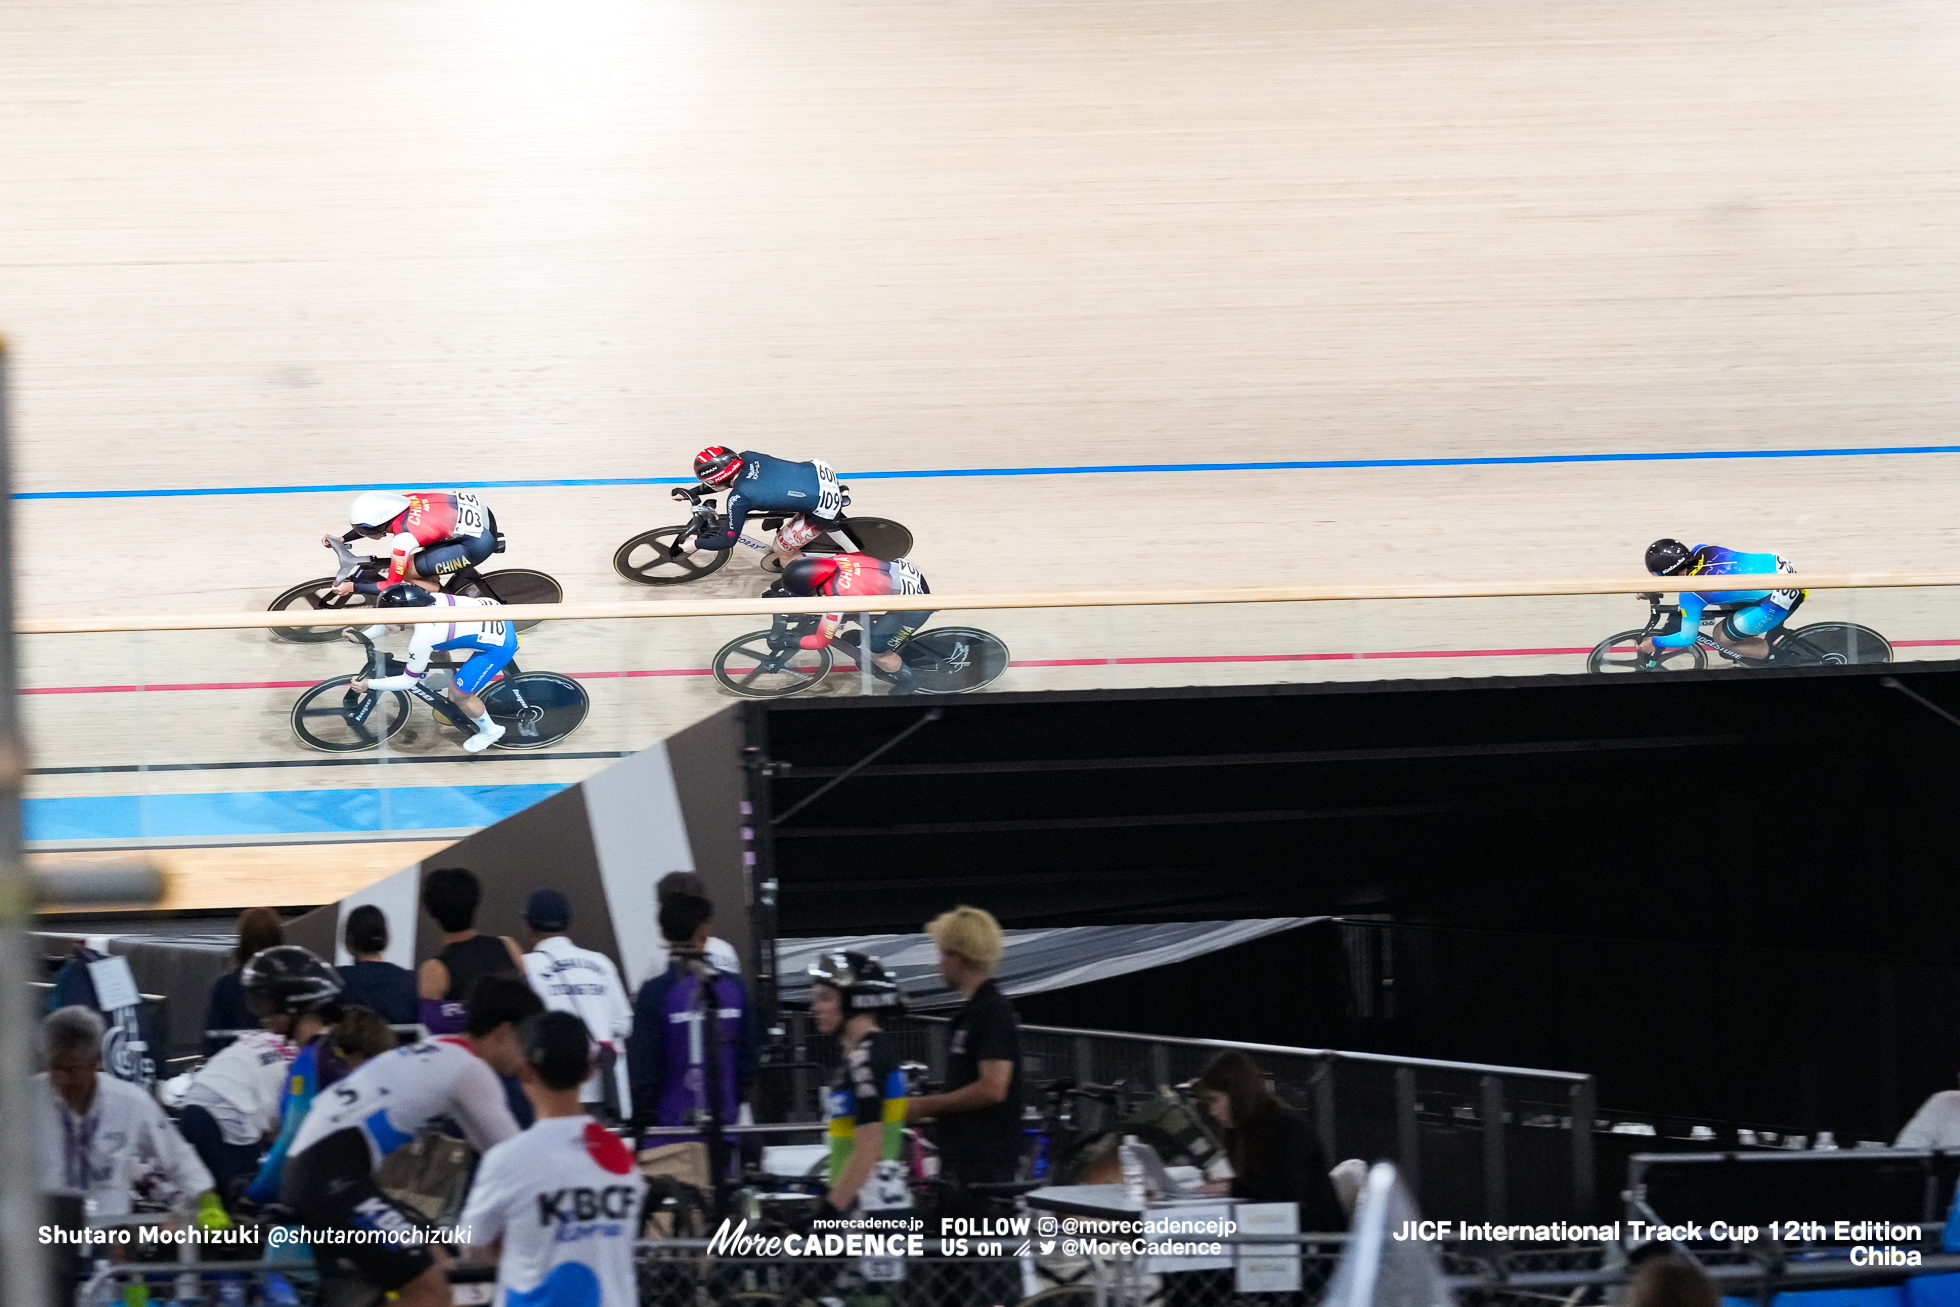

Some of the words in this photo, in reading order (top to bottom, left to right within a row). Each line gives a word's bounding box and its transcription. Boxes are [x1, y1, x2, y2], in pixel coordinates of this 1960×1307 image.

[700, 466, 718, 476] JAPAN
[819, 490, 840, 511] 109
[457, 507, 482, 528] 103
[435, 555, 471, 575] CHINA
[838, 556, 854, 589] CHINA
[887, 625, 915, 648] CHINA
